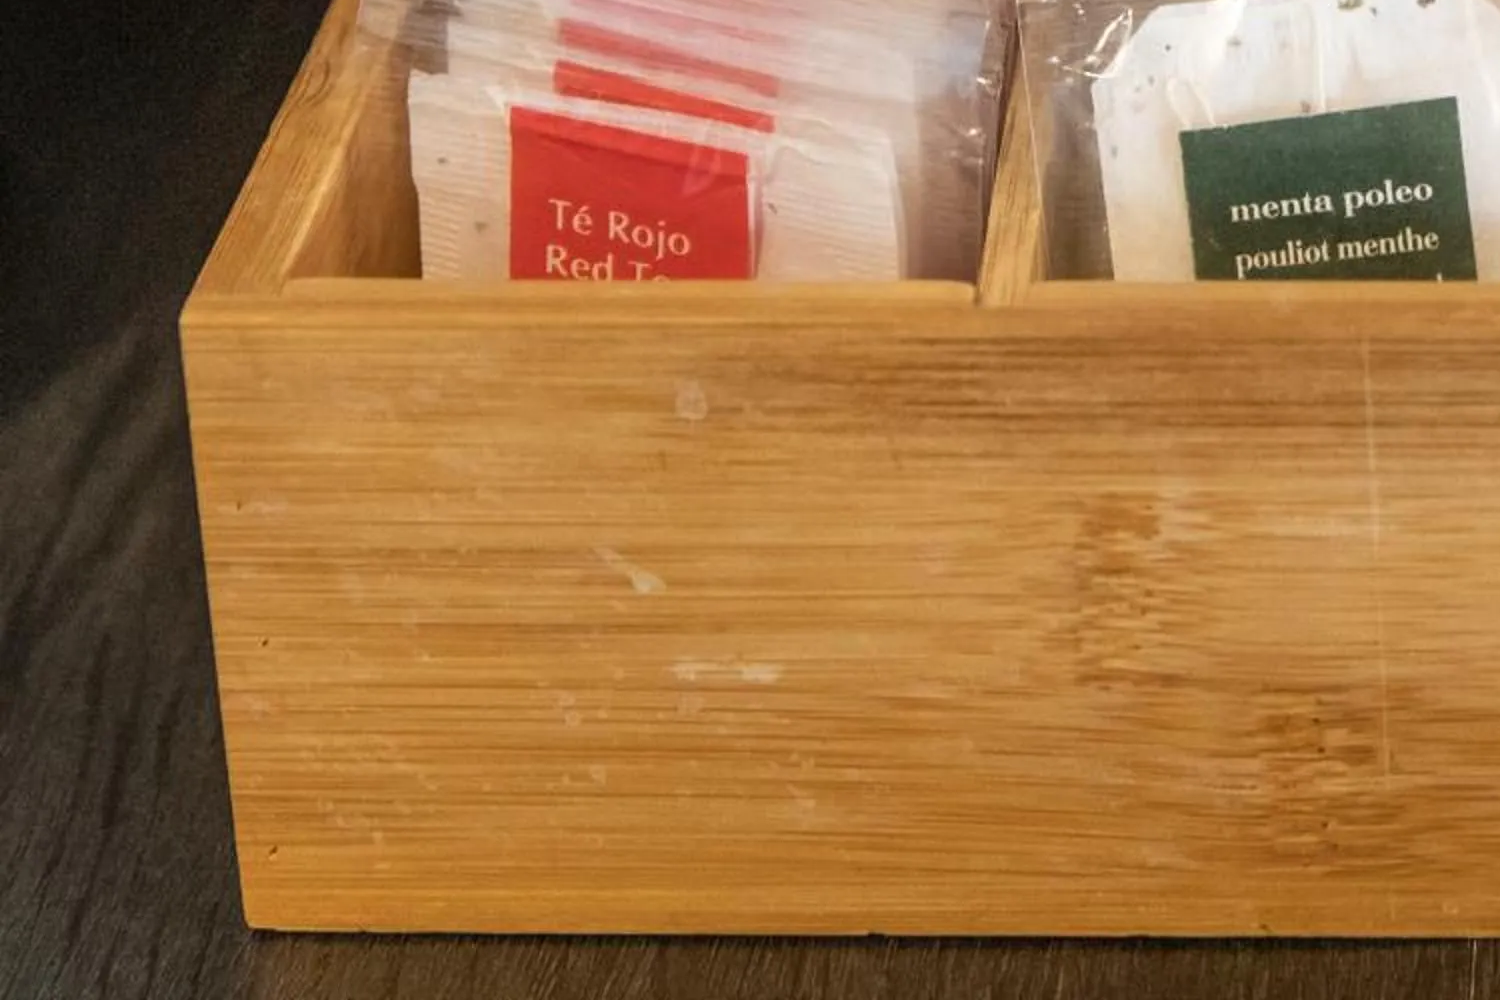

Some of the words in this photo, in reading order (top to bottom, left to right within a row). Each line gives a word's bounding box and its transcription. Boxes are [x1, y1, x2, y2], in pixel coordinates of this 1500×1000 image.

[1230, 191, 1334, 223] menta
[1343, 178, 1434, 218] poleo
[548, 198, 593, 236] Té
[608, 210, 692, 262] Rojo
[1235, 237, 1330, 280] pouliot
[1336, 226, 1440, 261] menthe
[546, 244, 614, 281] Red
